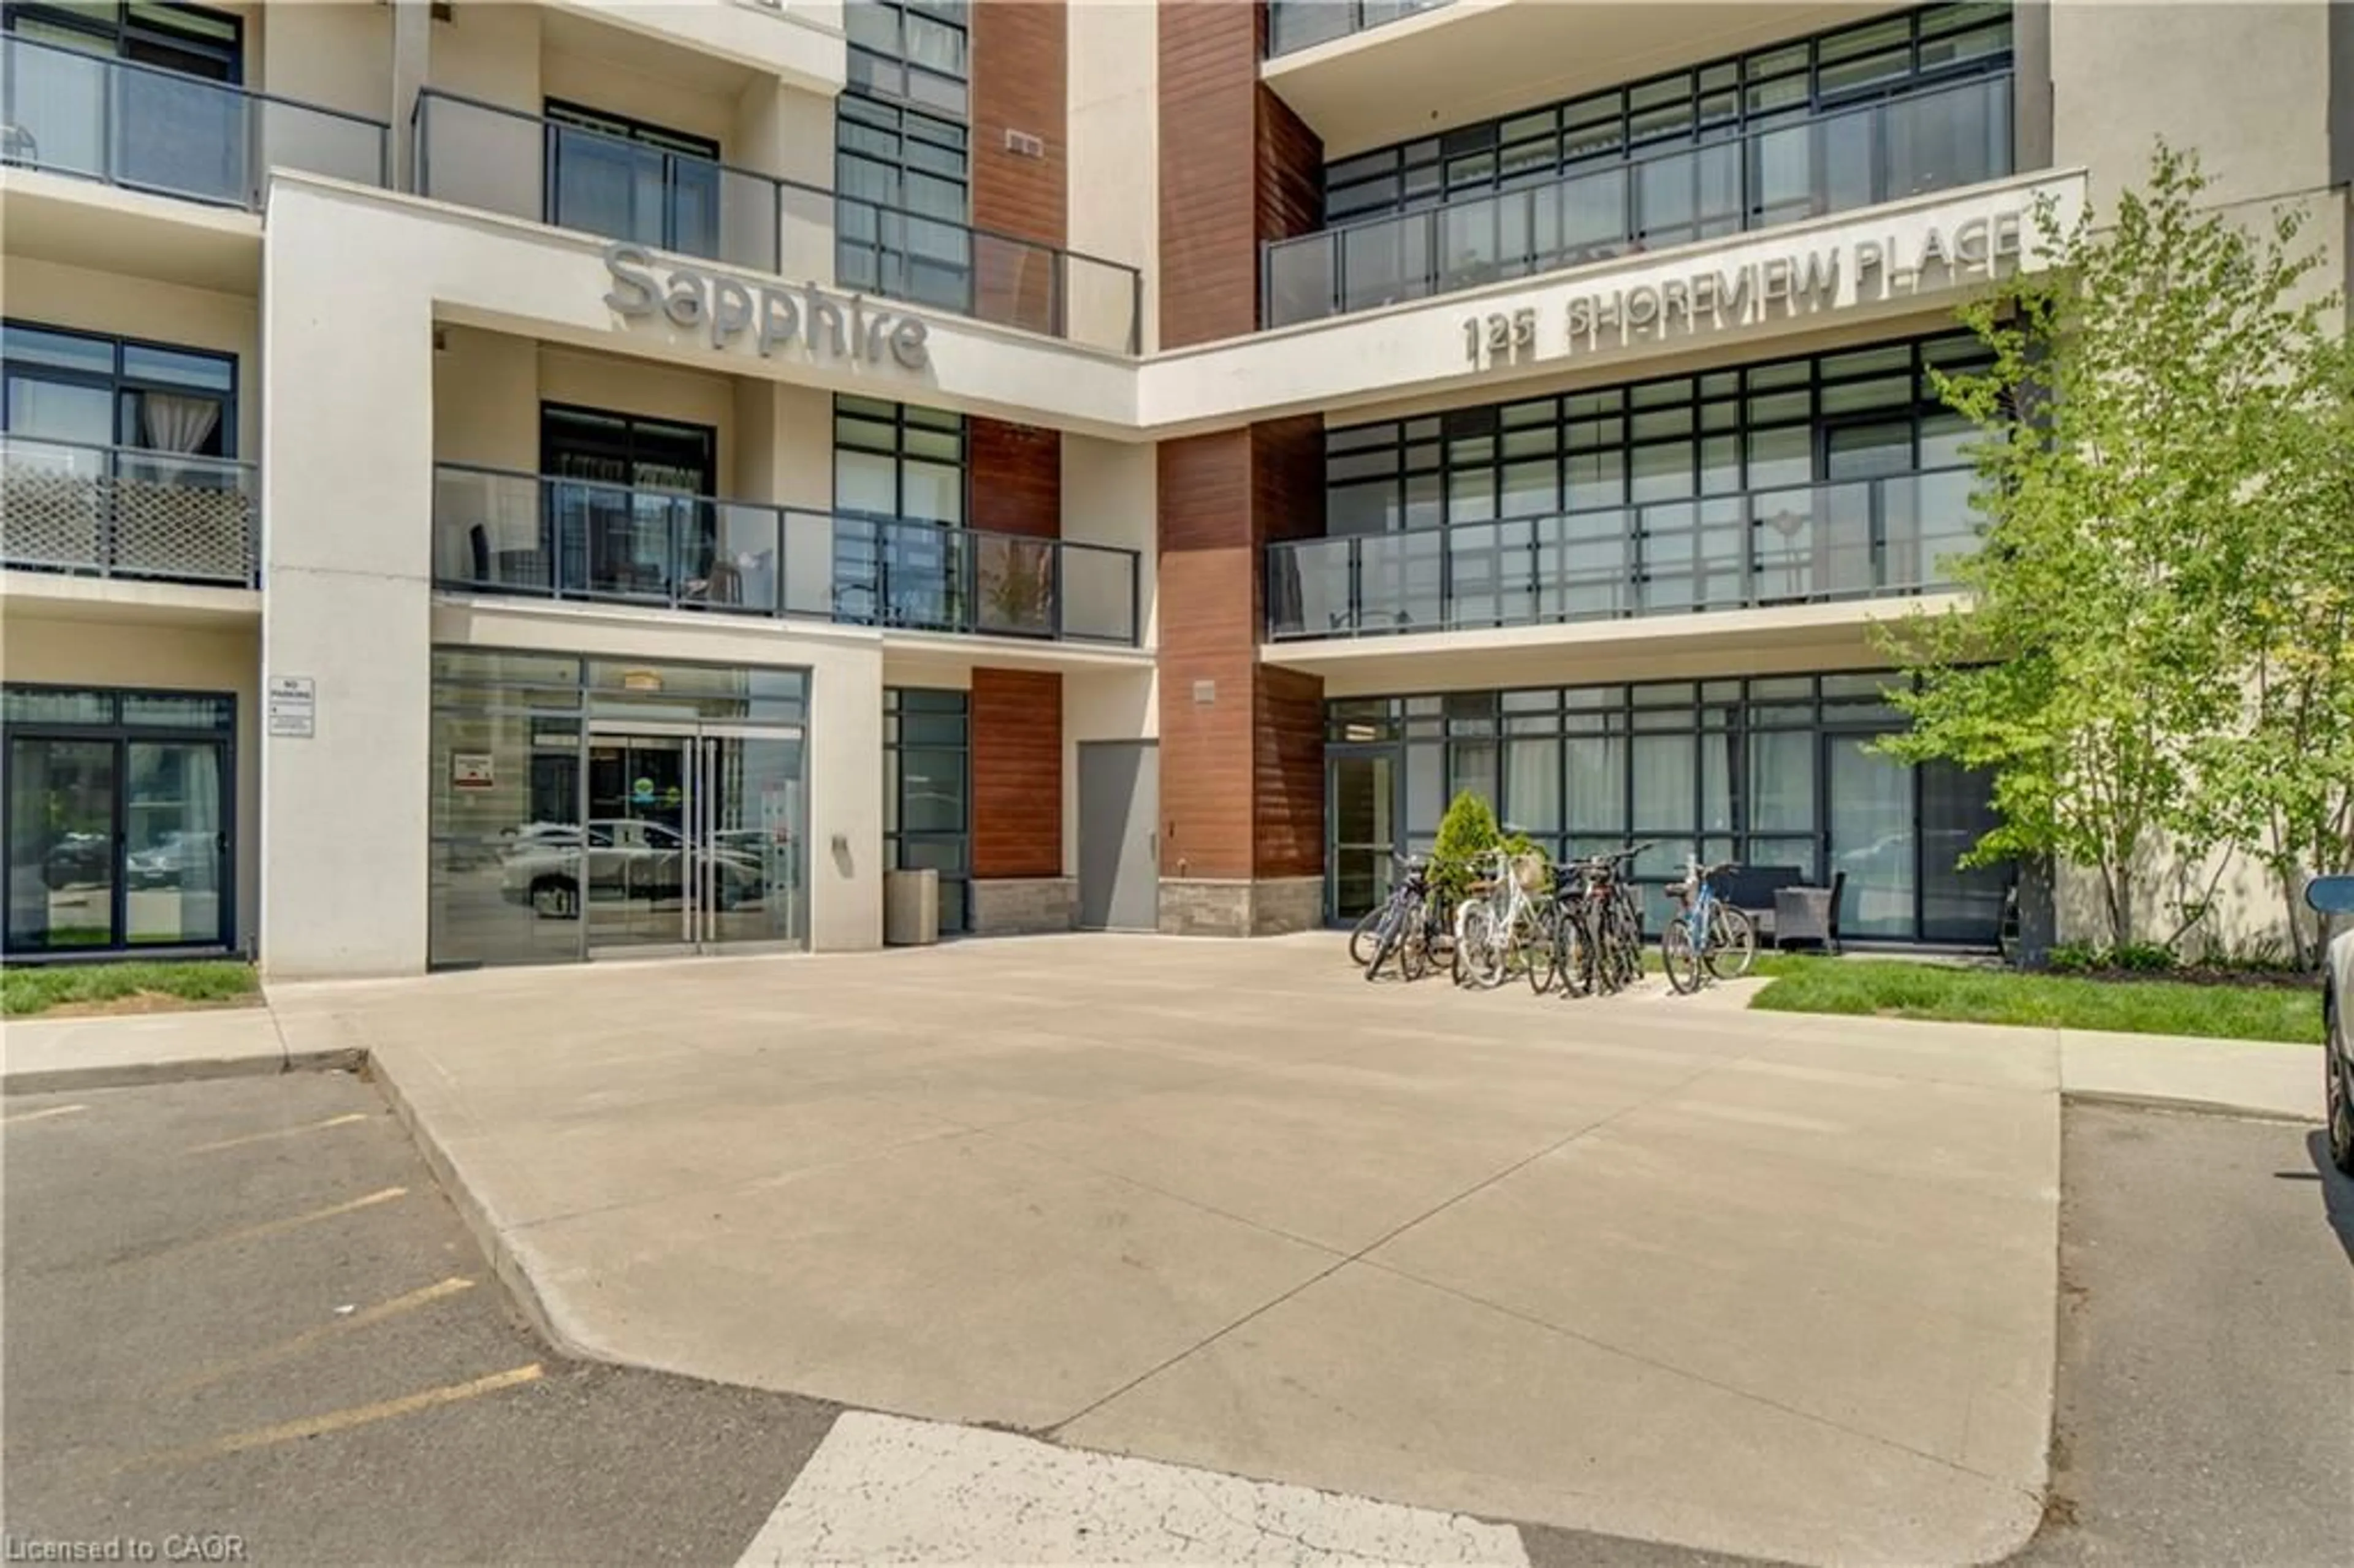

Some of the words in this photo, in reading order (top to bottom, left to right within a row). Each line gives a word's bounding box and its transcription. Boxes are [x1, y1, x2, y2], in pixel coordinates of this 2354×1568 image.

[603, 244, 929, 370] Sapphire
[1463, 306, 1536, 363] 125
[1565, 246, 1840, 335] SHOREVIEW
[1854, 211, 2021, 285] PLACE
